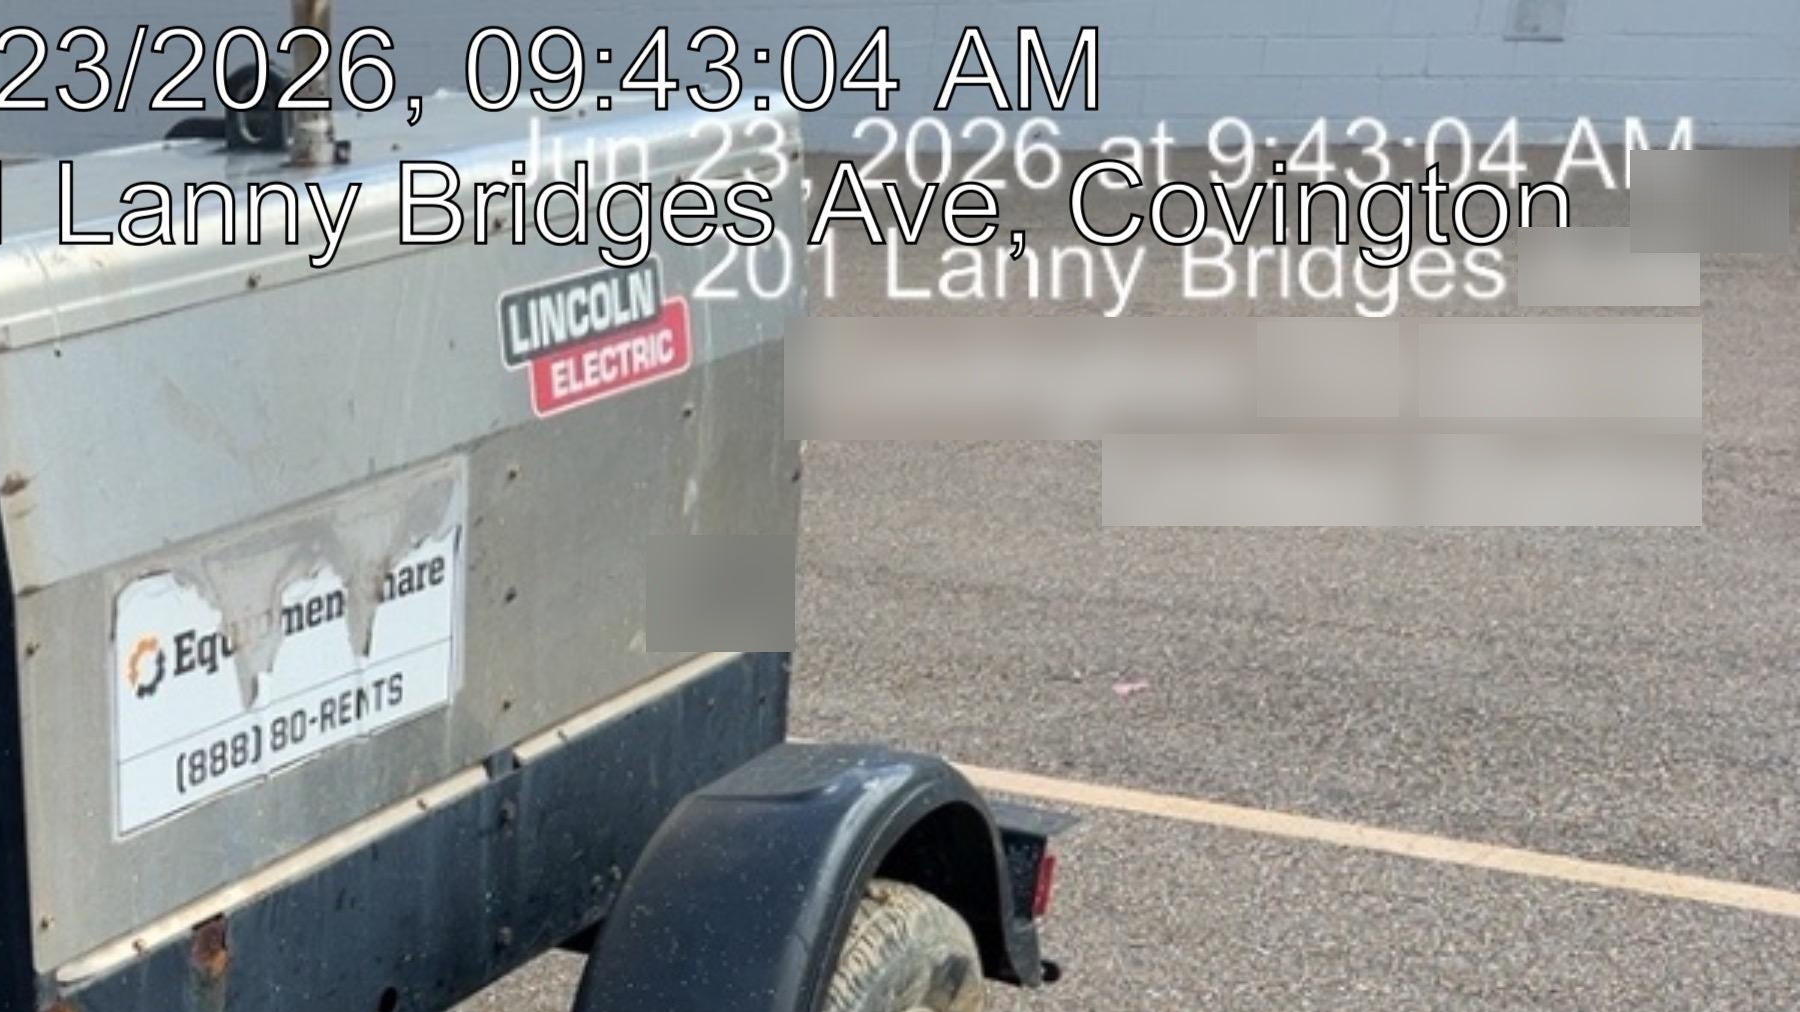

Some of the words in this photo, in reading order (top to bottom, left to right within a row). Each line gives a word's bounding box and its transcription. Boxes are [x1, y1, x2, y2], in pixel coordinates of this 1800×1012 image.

[508, 269, 656, 355] LINCOLN
[550, 328, 675, 399] ELECTRIC
[176, 725, 263, 793] (888)
[270, 673, 404, 753] 80-RENTS
